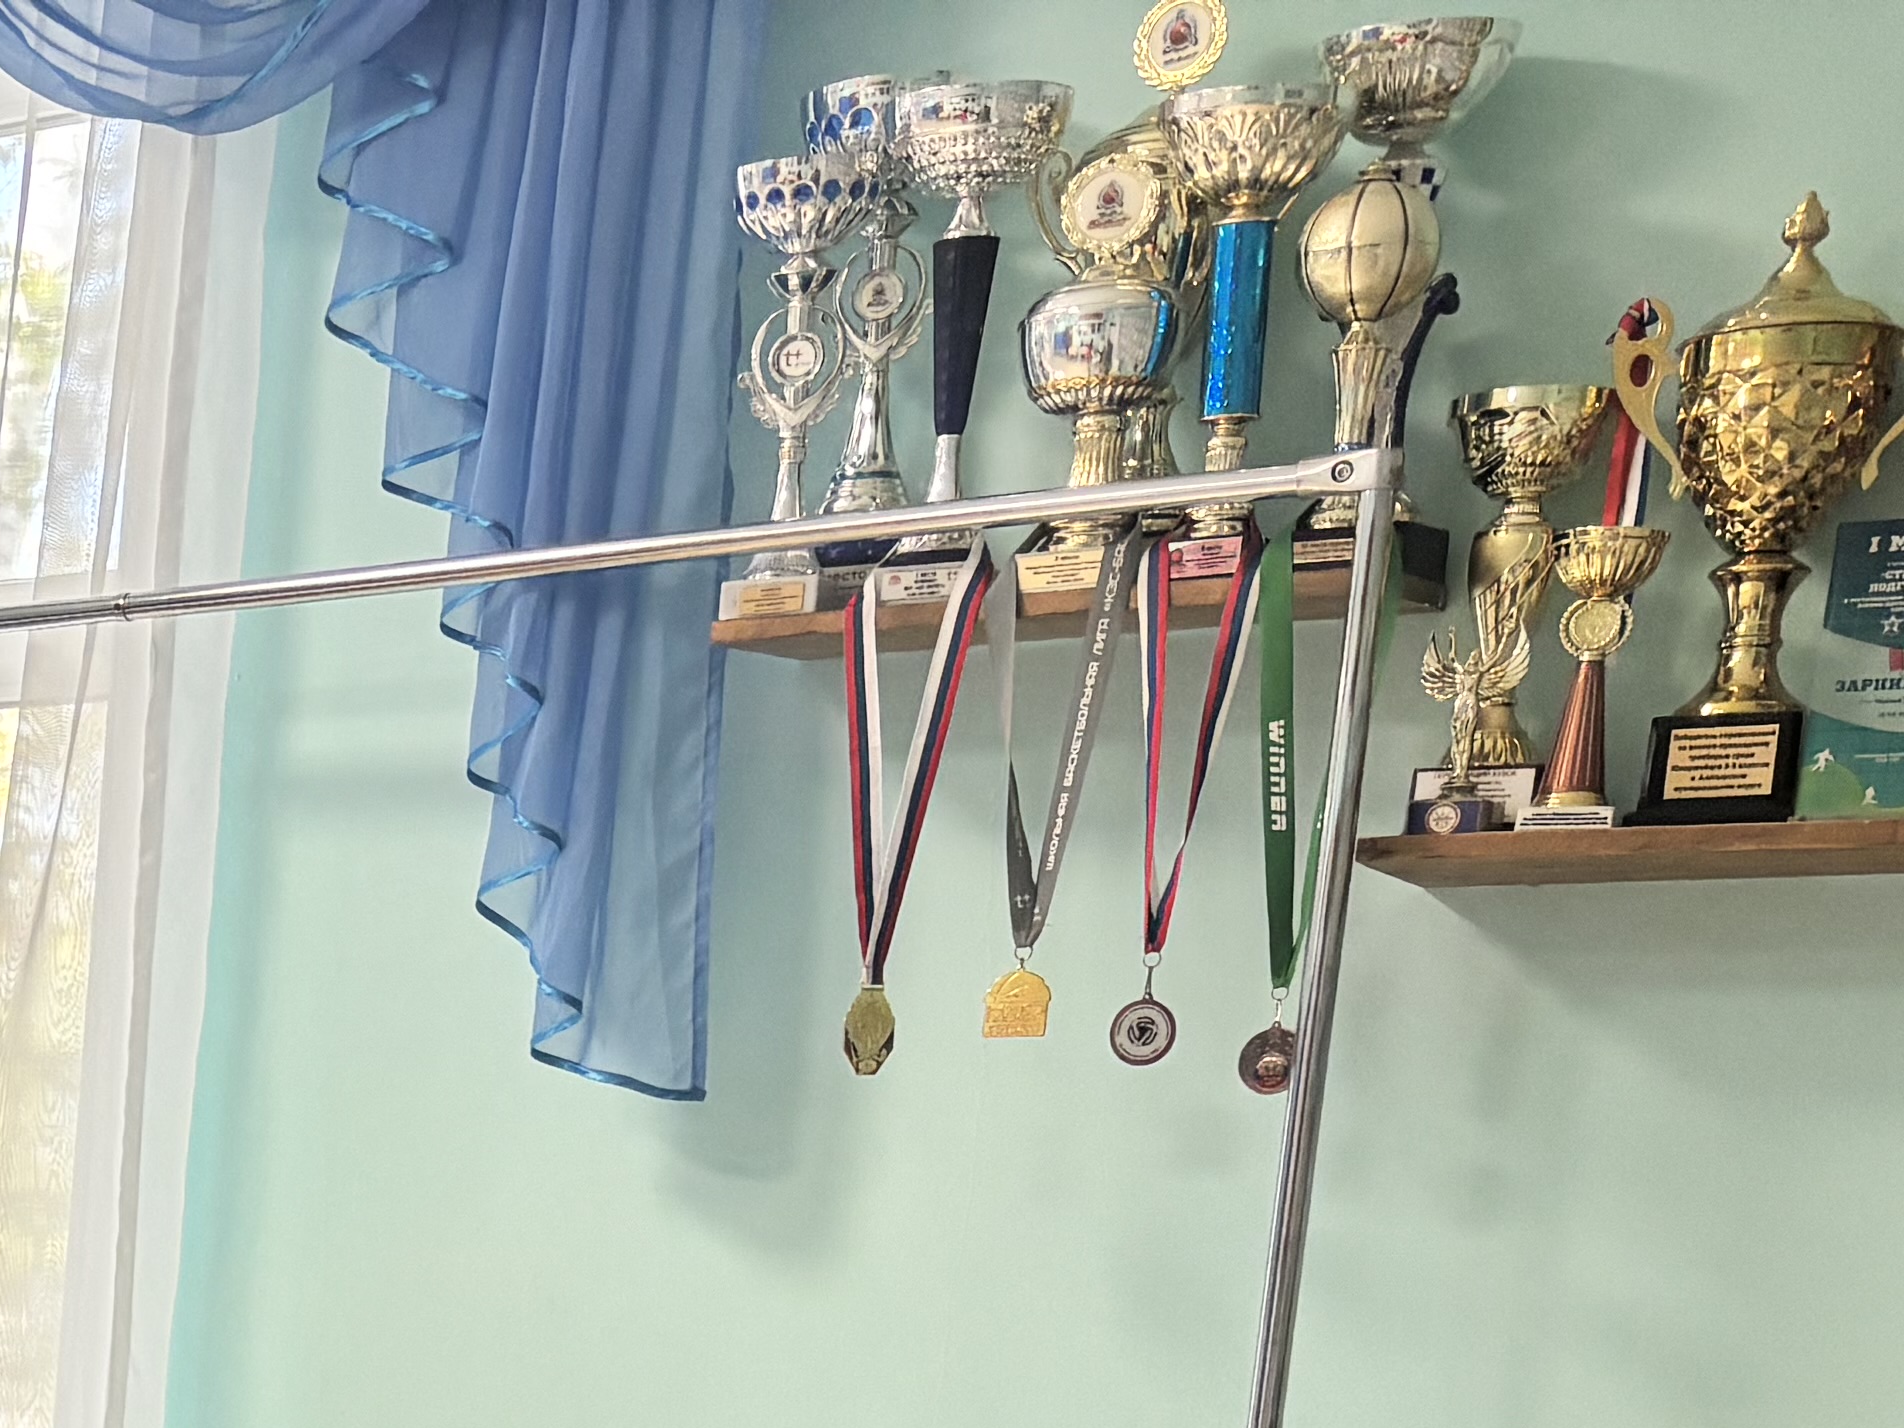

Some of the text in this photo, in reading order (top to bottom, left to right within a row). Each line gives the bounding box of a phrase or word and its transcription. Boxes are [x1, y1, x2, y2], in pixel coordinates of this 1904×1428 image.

[1045, 792, 1069, 871] ШКОЛЬНАЯ
[1063, 661, 1100, 787] БАСКЕТБОЛЬНАЯ
[1093, 618, 1110, 655] ЛИГА
